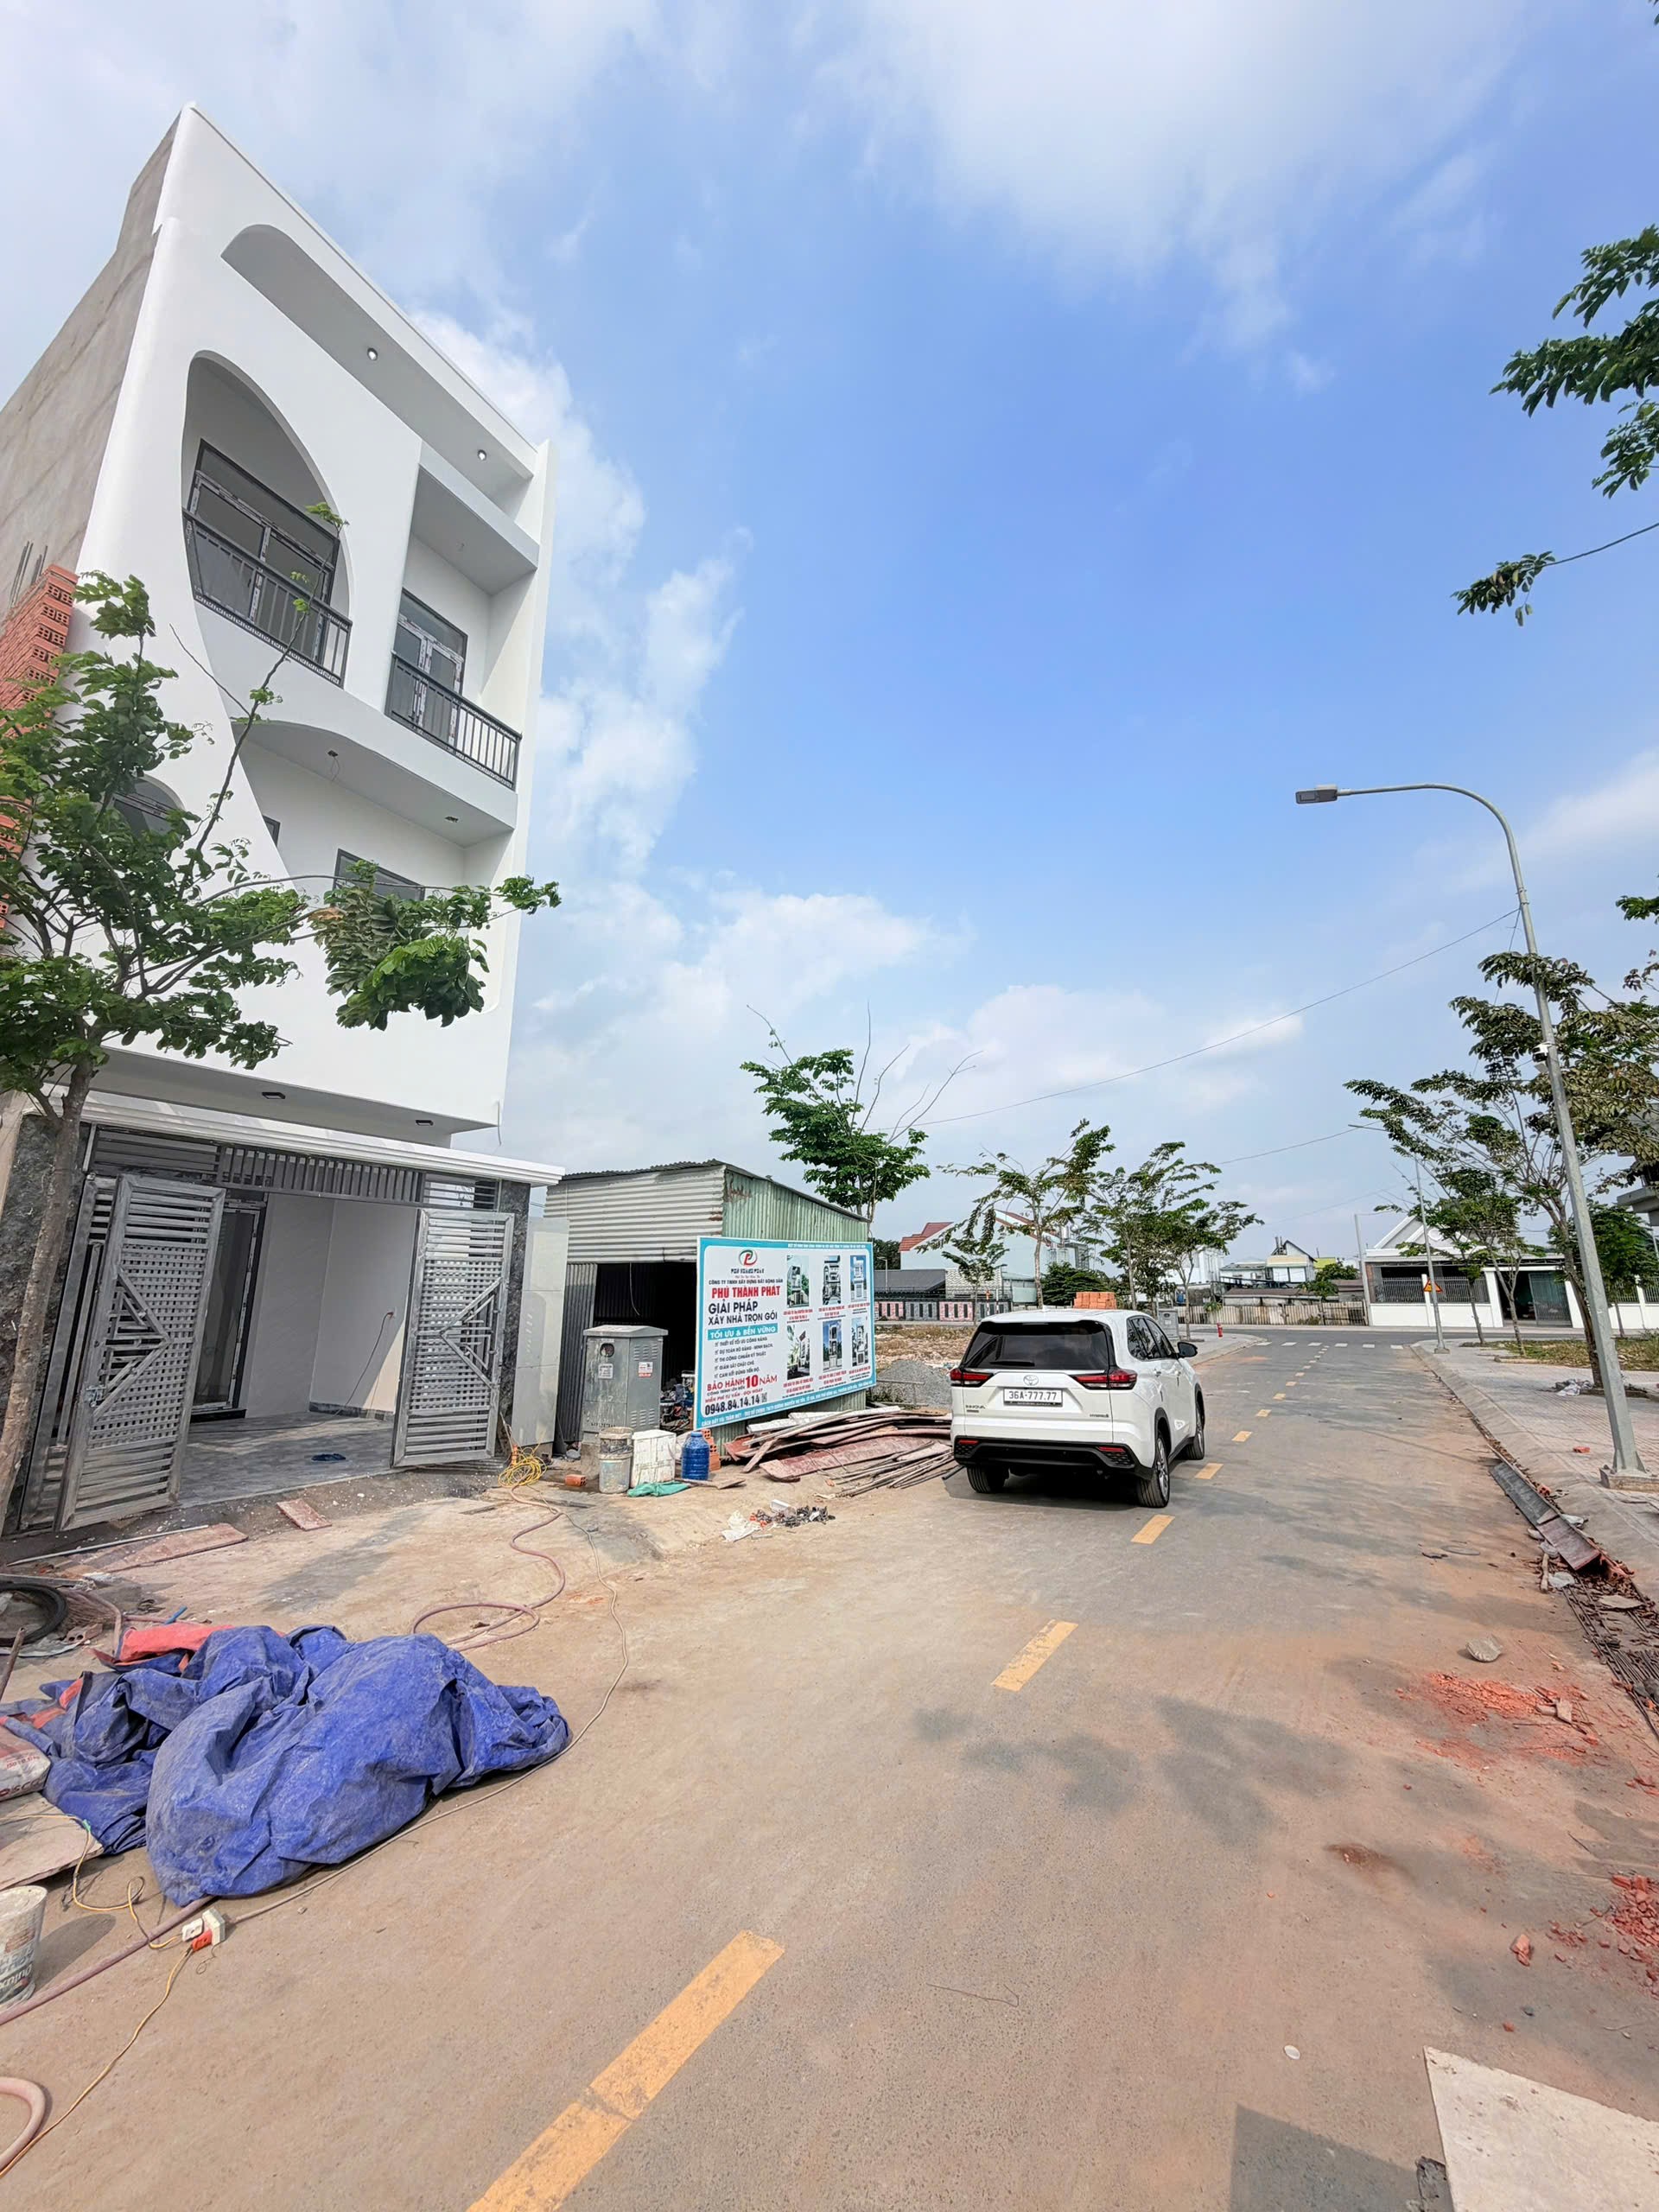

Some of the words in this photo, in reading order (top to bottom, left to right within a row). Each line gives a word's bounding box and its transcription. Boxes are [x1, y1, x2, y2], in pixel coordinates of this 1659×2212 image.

[712, 1286, 729, 1298] PHÚ
[733, 1286, 759, 1298] THÀNH
[761, 1285, 780, 1296] PHÁT
[709, 1299, 730, 1314] GIẢI
[734, 1299, 758, 1313] PHÁP
[709, 1314, 724, 1325] XÂY
[727, 1313, 743, 1324] NHÀ
[745, 1313, 763, 1324] TRỌN
[765, 1310, 778, 1320] GÓI
[710, 1330, 722, 1339] TỐI
[758, 1325, 776, 1334] VỮNG
[707, 1381, 723, 1391] BẢO
[725, 1377, 745, 1388] HÀNH
[746, 1375, 759, 1389] 10
[760, 1375, 778, 1385] NĂM
[705, 1395, 760, 1415] 0948.84.14.14
